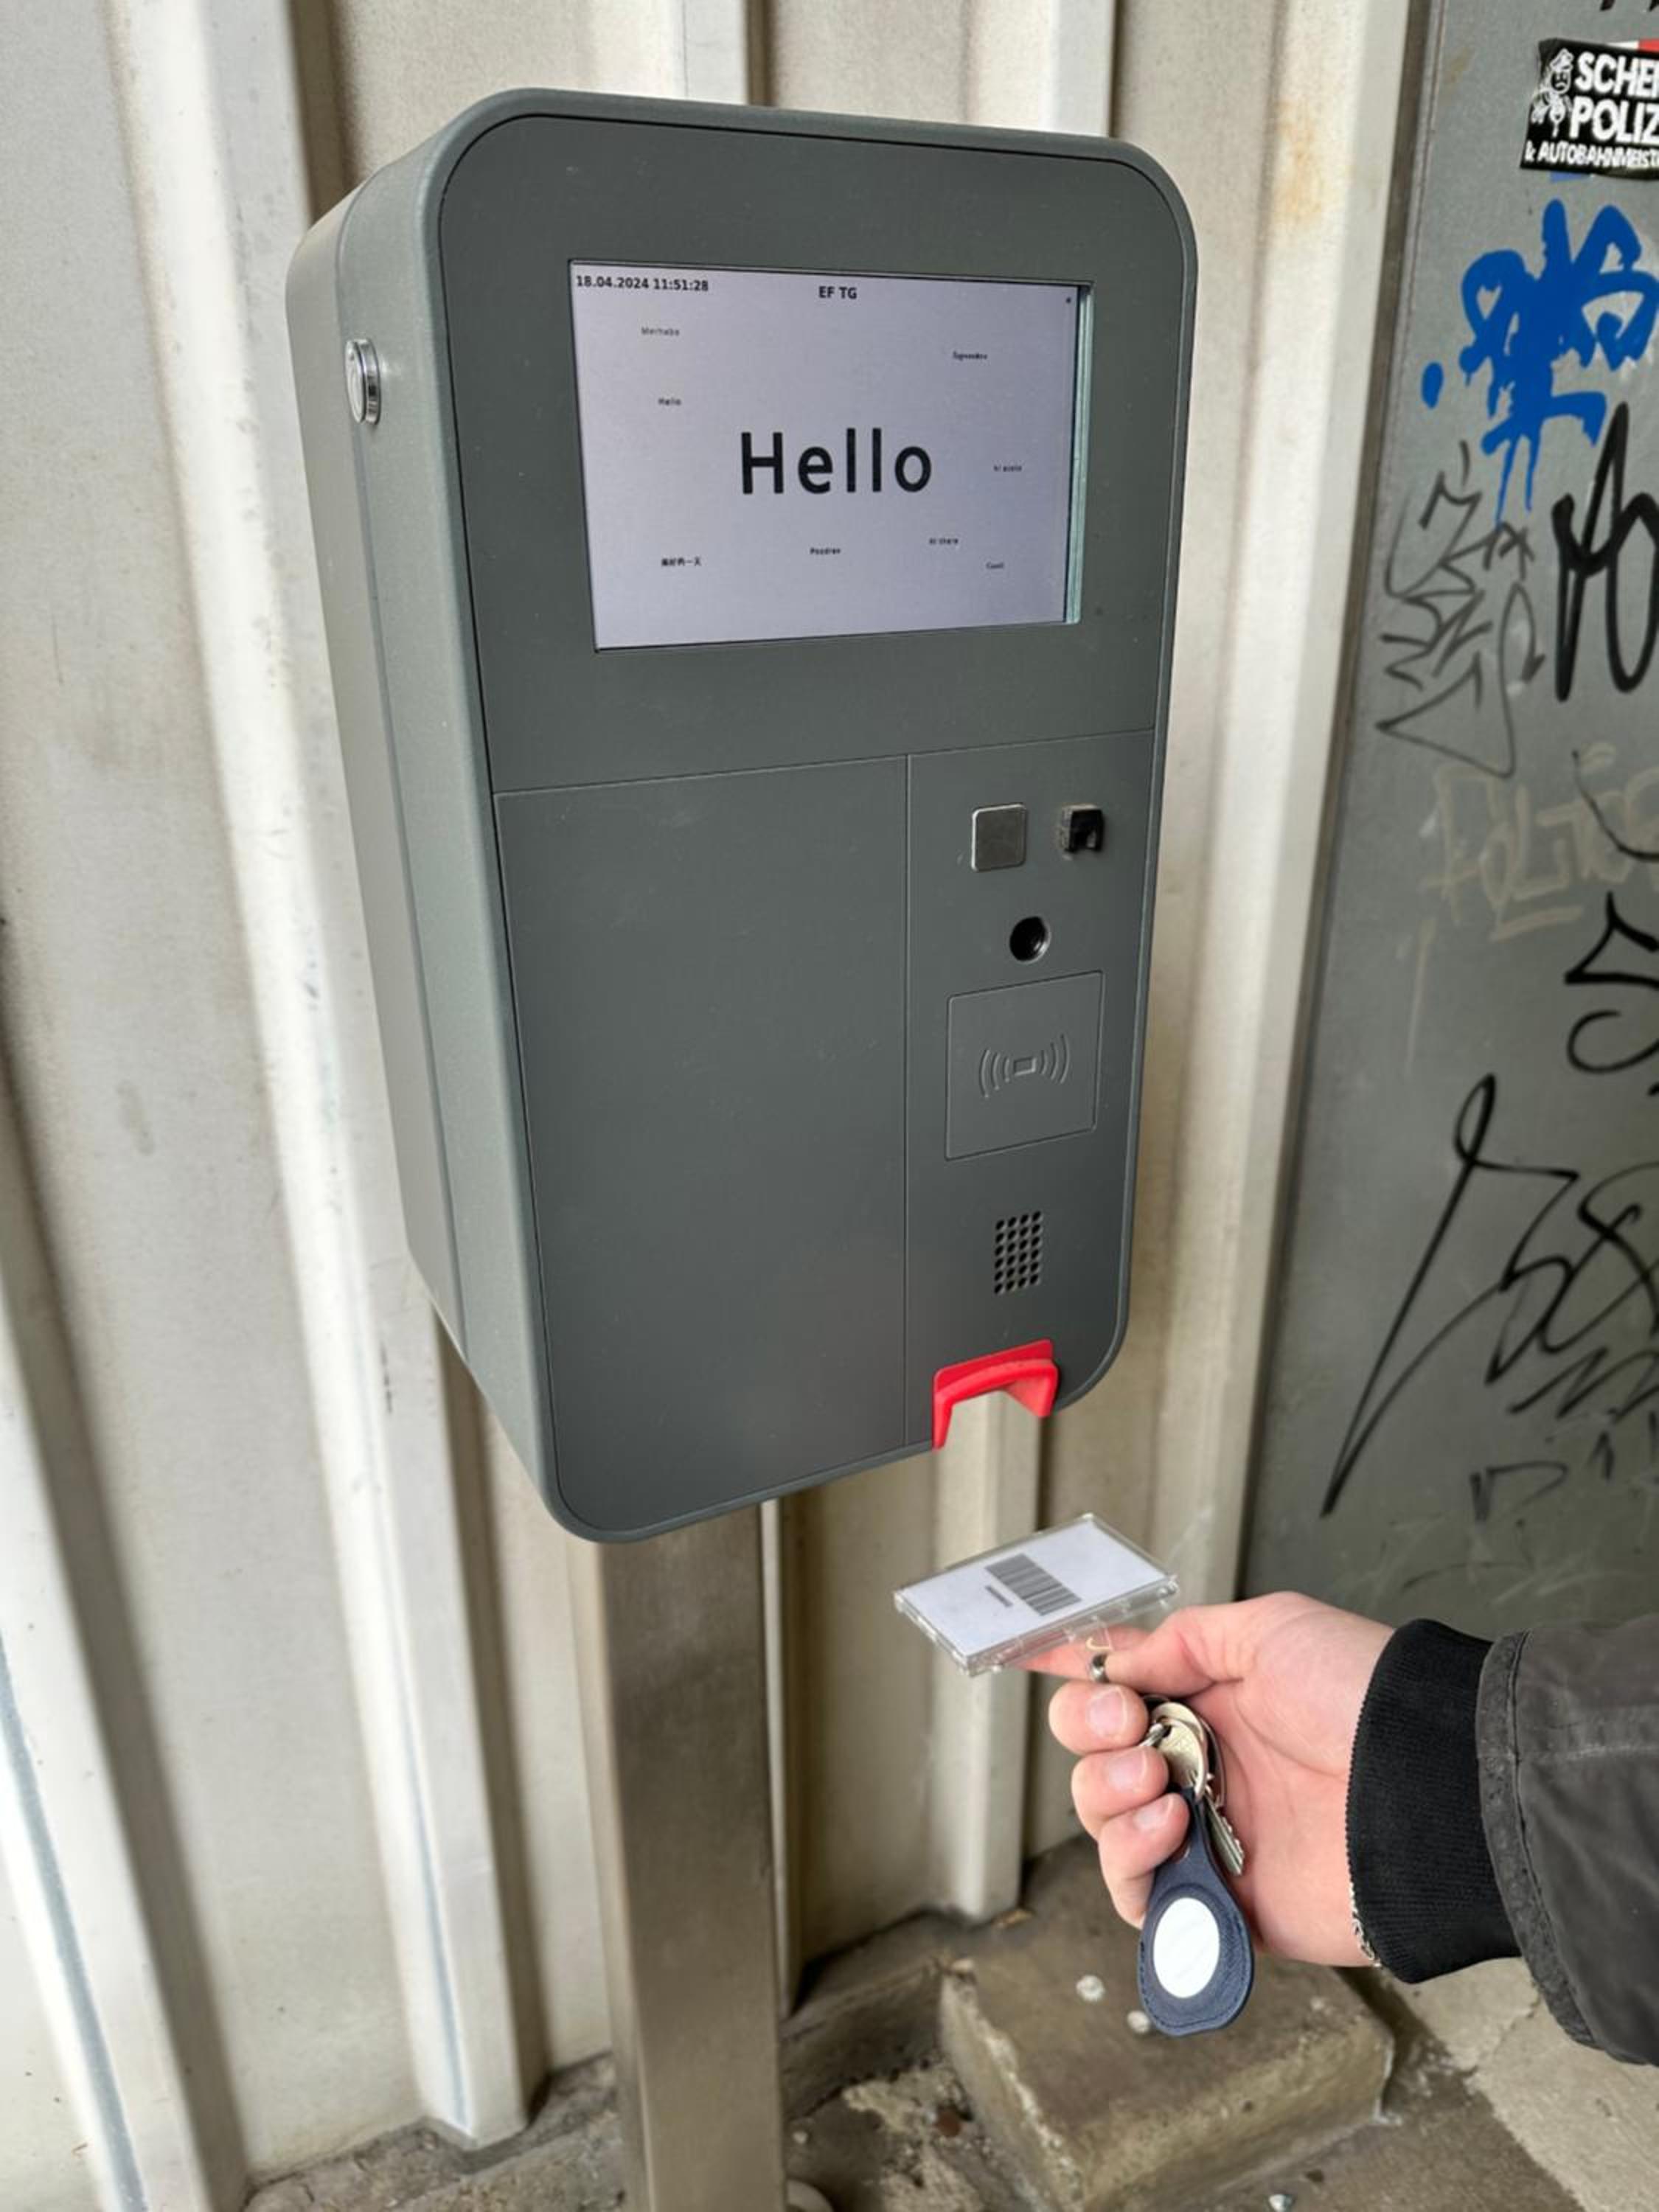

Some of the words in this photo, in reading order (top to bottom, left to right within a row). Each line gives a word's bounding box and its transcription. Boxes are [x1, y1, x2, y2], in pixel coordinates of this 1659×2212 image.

[577, 275, 649, 288] 18.04.2024
[654, 278, 708, 291] 11:51:28
[818, 285, 835, 299] EF
[839, 286, 858, 299] TG
[741, 427, 932, 495] Hello
